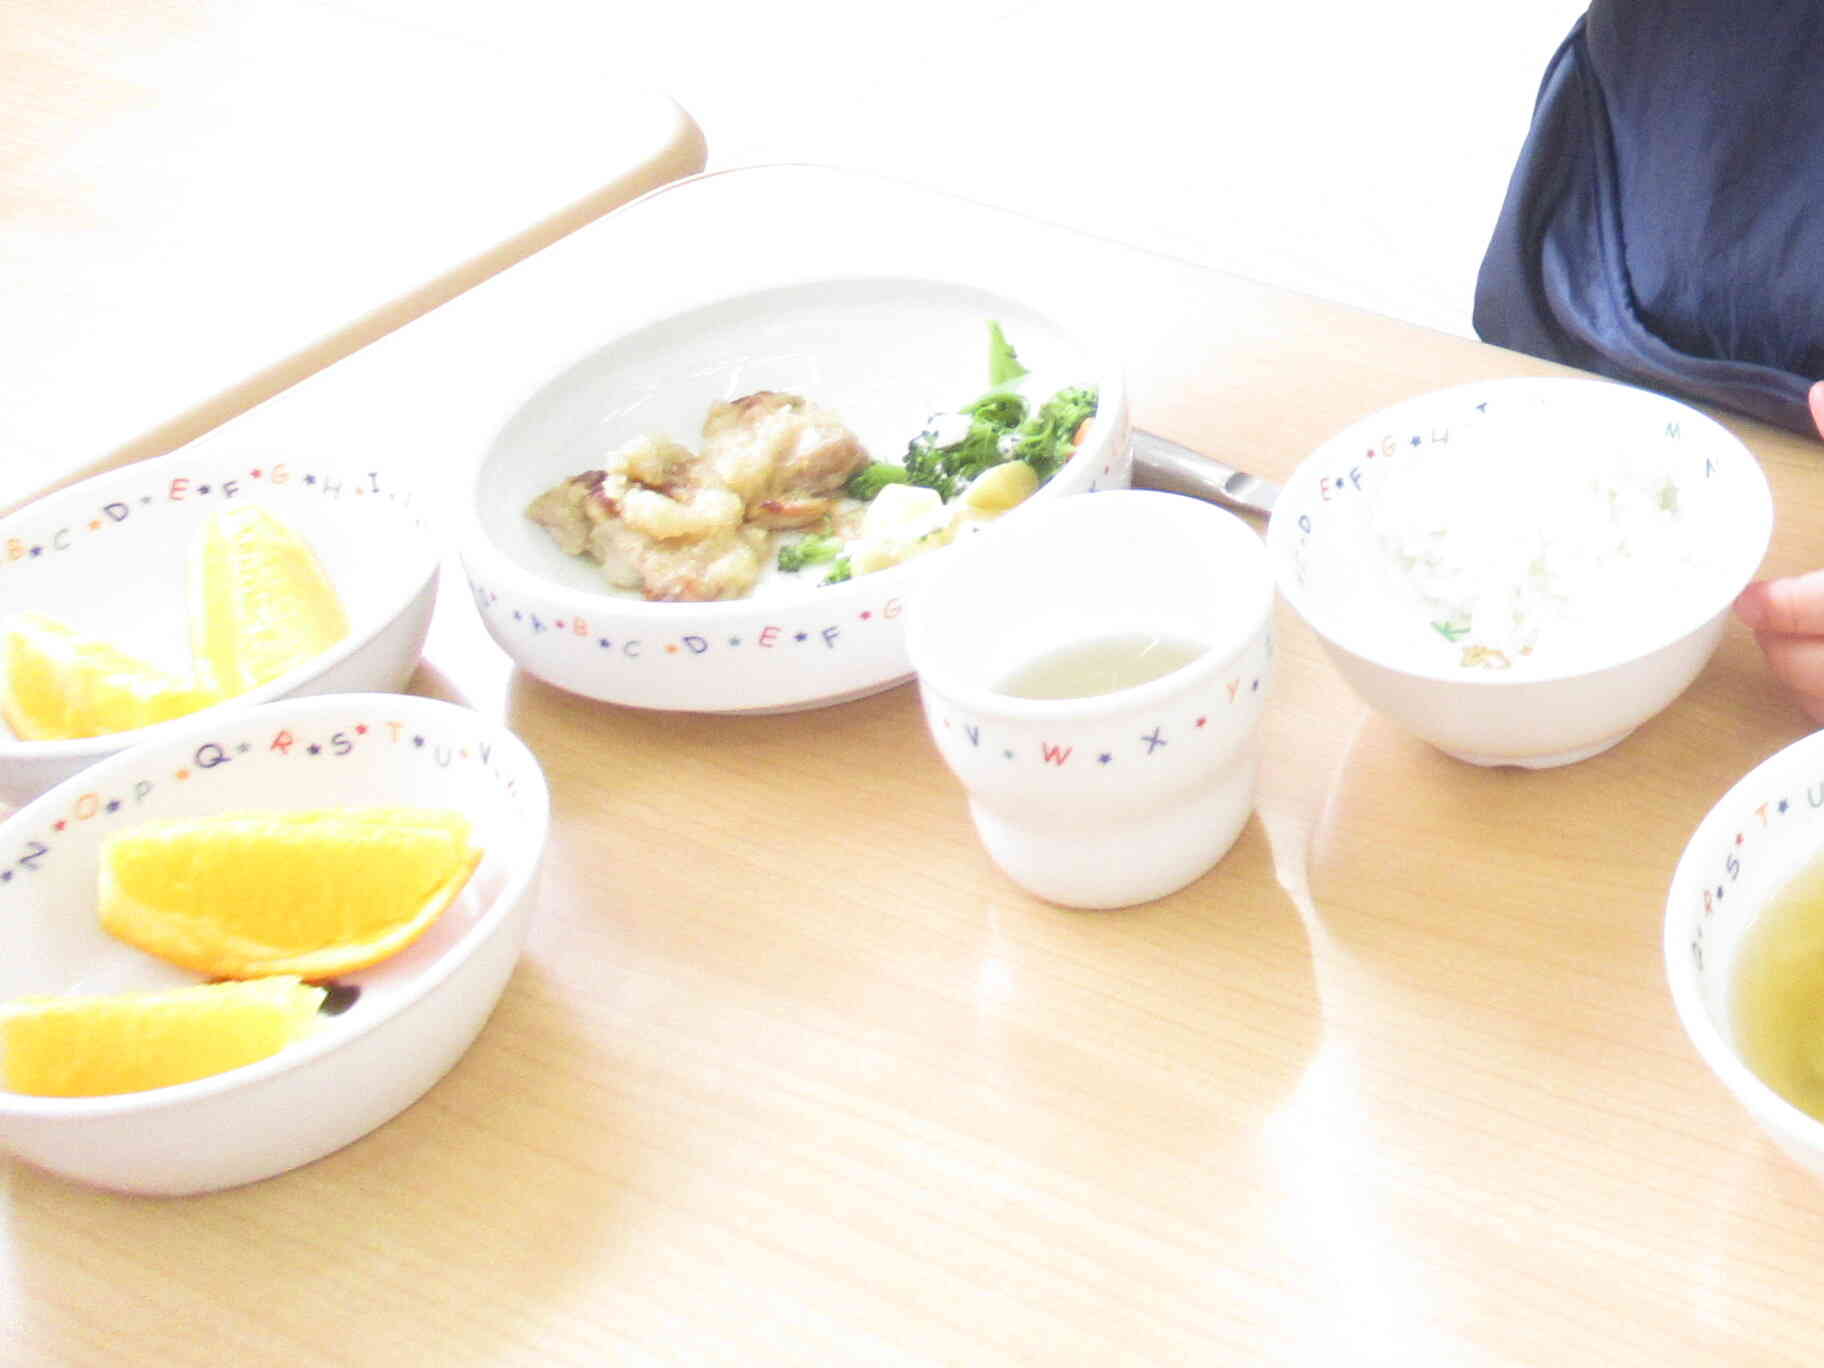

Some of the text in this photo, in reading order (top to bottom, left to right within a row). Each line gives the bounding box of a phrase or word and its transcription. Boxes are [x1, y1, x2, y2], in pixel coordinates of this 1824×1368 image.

[53, 528, 73, 551] C
[103, 501, 129, 522] D
[168, 477, 190, 501] E
[221, 479, 240, 499] F
[271, 464, 290, 485] G
[323, 476, 342, 500] H
[367, 471, 380, 493] I
[1348, 464, 1361, 491] F
[621, 639, 642, 658] C
[681, 633, 709, 654] D
[759, 625, 783, 648] E
[820, 625, 842, 650] F
[882, 597, 902, 620] G
[963, 678, 1241, 767] V W X Y
[73, 792, 99, 821] O
[133, 779, 154, 803] P
[193, 742, 231, 769] Q
[269, 729, 295, 755] R
[330, 732, 354, 757] S
[386, 721, 404, 744] T
[434, 746, 453, 768] U
[479, 741, 493, 765] V
[1725, 853, 1741, 881] S
[1754, 802, 1770, 828] T
